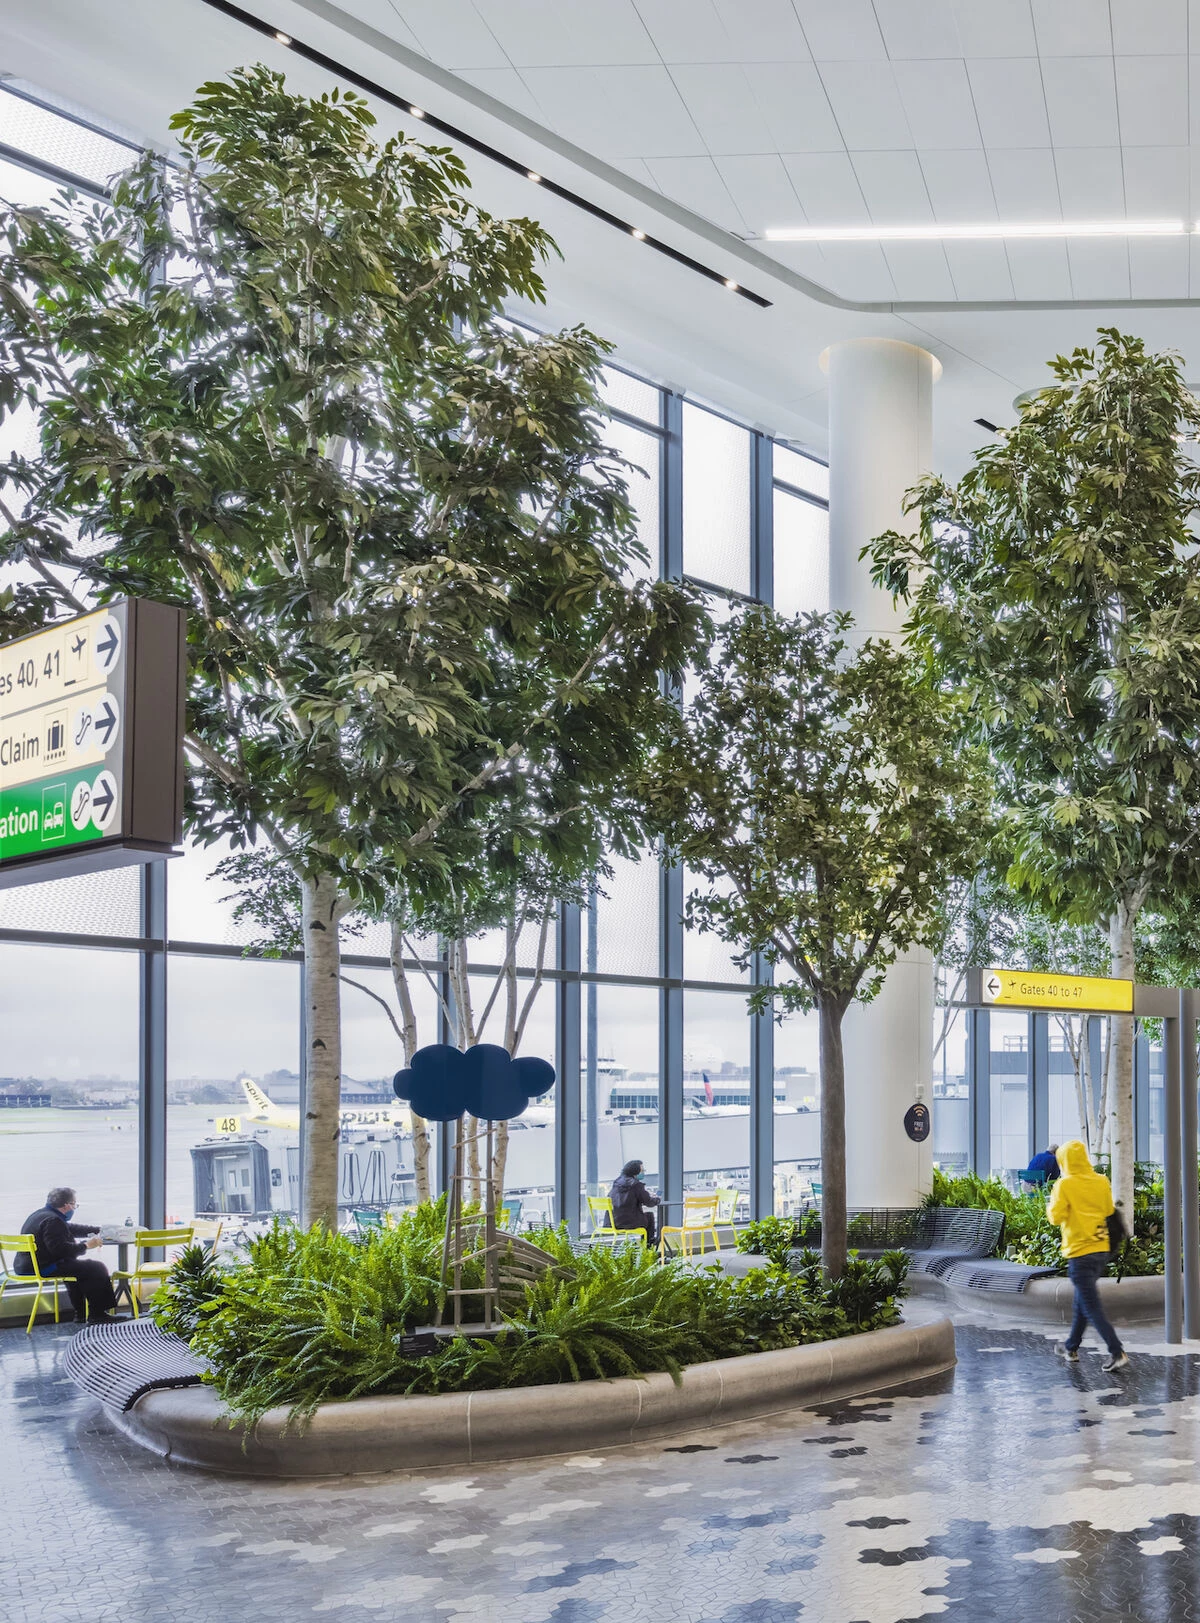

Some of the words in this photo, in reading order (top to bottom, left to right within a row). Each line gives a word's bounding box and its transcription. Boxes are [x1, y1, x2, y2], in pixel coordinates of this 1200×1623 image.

[17, 659, 38, 688] 40,
[43, 650, 60, 679] 41
[0, 732, 39, 766] Claim
[1020, 983, 1046, 996] Gates
[1048, 985, 1058, 996] 40
[1061, 987, 1070, 997] to
[1073, 987, 1083, 998] 47
[221, 1117, 237, 1134] 48
[342, 1110, 391, 1125] pirit
